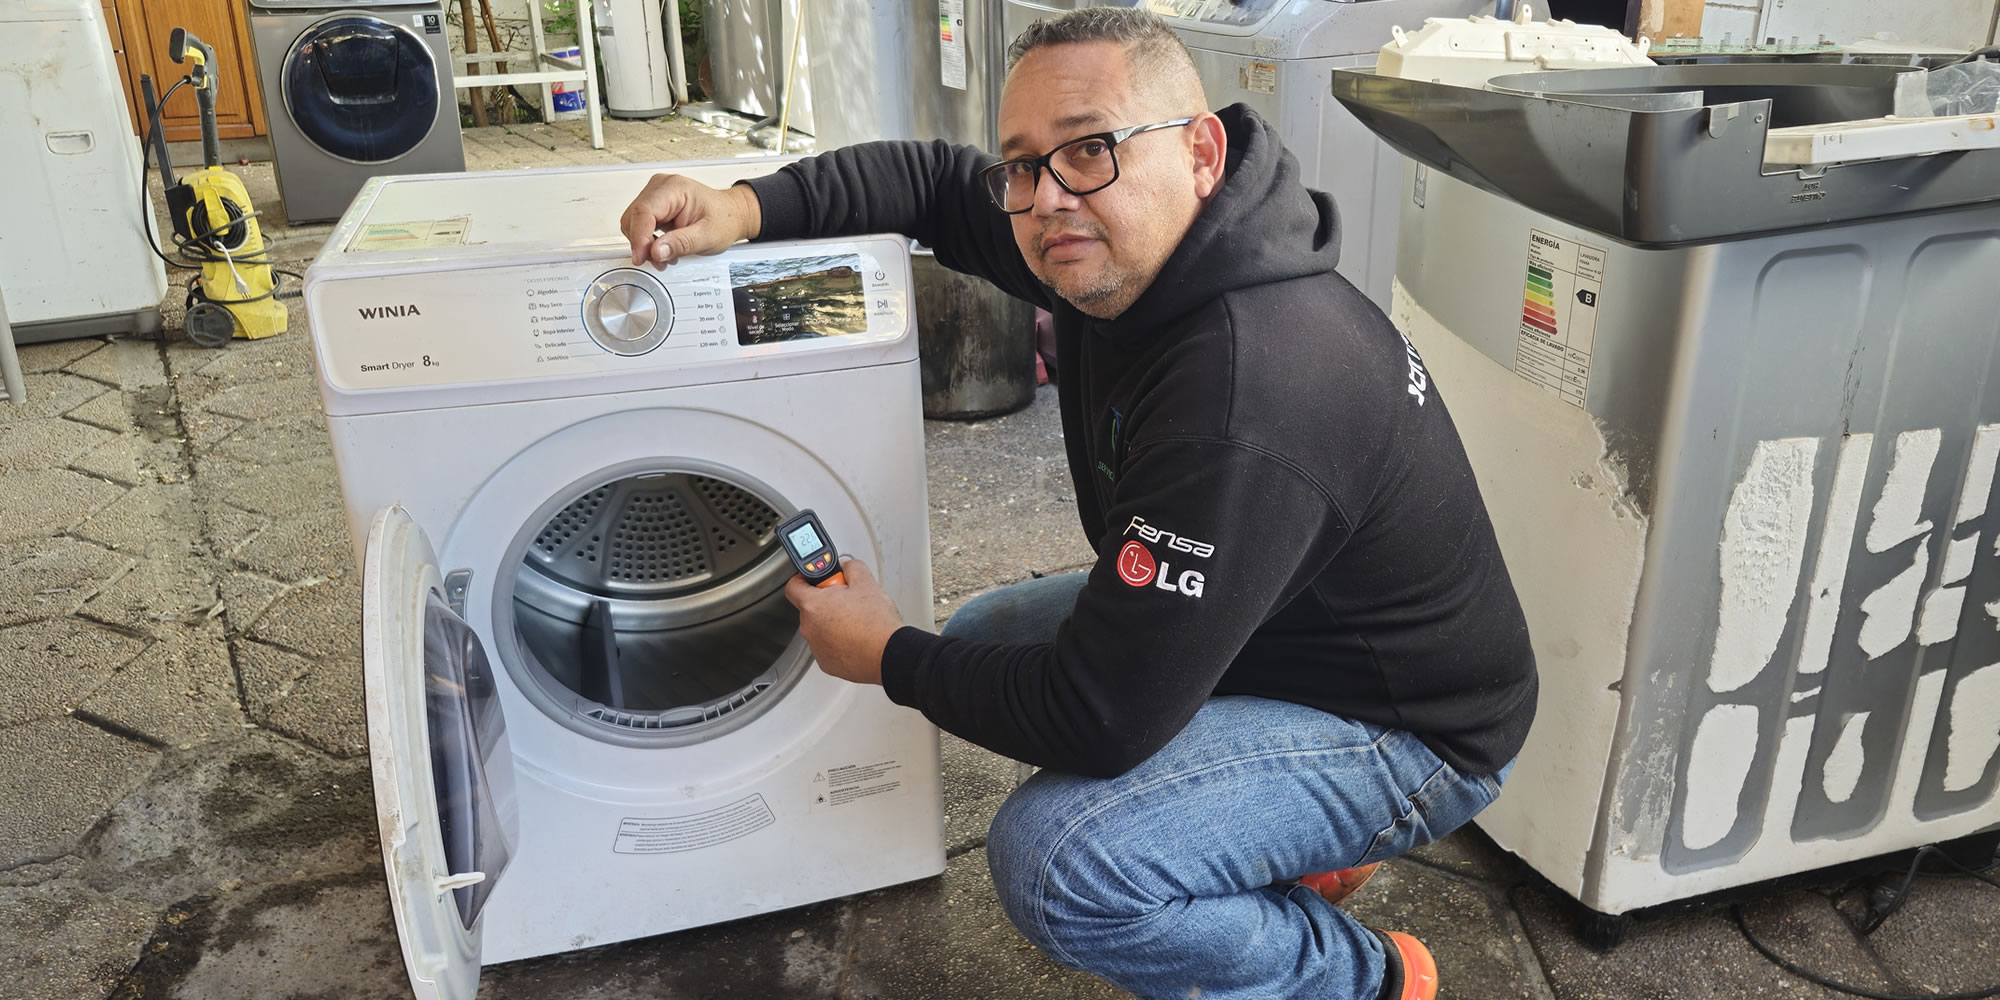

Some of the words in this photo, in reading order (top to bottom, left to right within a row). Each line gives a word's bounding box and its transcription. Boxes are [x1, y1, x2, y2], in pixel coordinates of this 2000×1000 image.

[1531, 234, 1560, 250] ENERGÍA
[1585, 293, 1592, 303] B
[358, 304, 421, 320] WINIA
[541, 314, 568, 322] Planchado
[360, 363, 390, 373] Smart
[391, 361, 415, 371] Dryer
[1123, 515, 1215, 559] Fensa
[1155, 560, 1205, 598] LG
